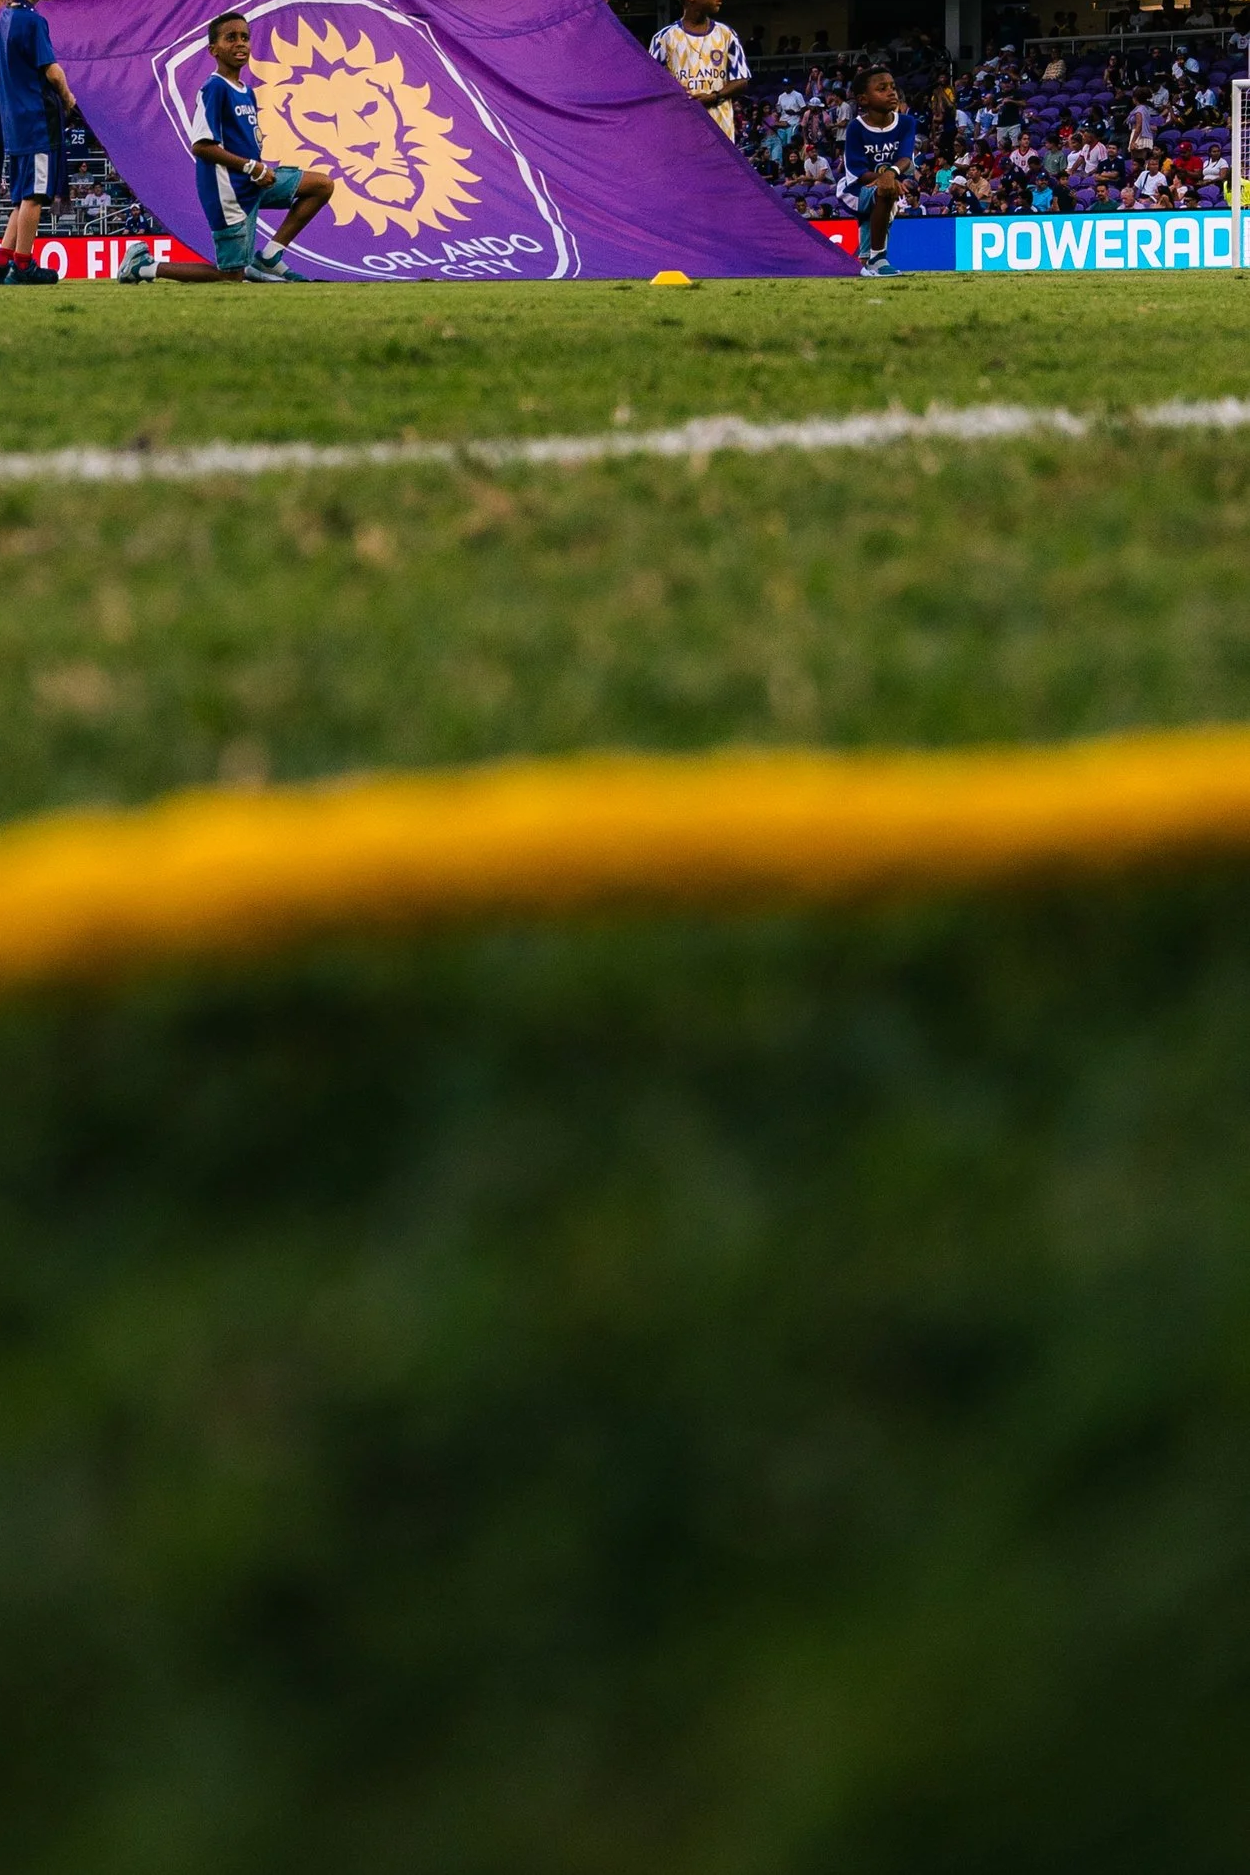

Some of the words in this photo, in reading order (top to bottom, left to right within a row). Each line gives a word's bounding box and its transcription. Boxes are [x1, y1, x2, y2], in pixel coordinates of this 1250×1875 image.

[687, 80, 714, 91] CITY
[71, 134, 85, 145] 25
[362, 233, 543, 272] ORLANDO
[972, 217, 1250, 270] POWERAD
[440, 259, 523, 278] CITY
